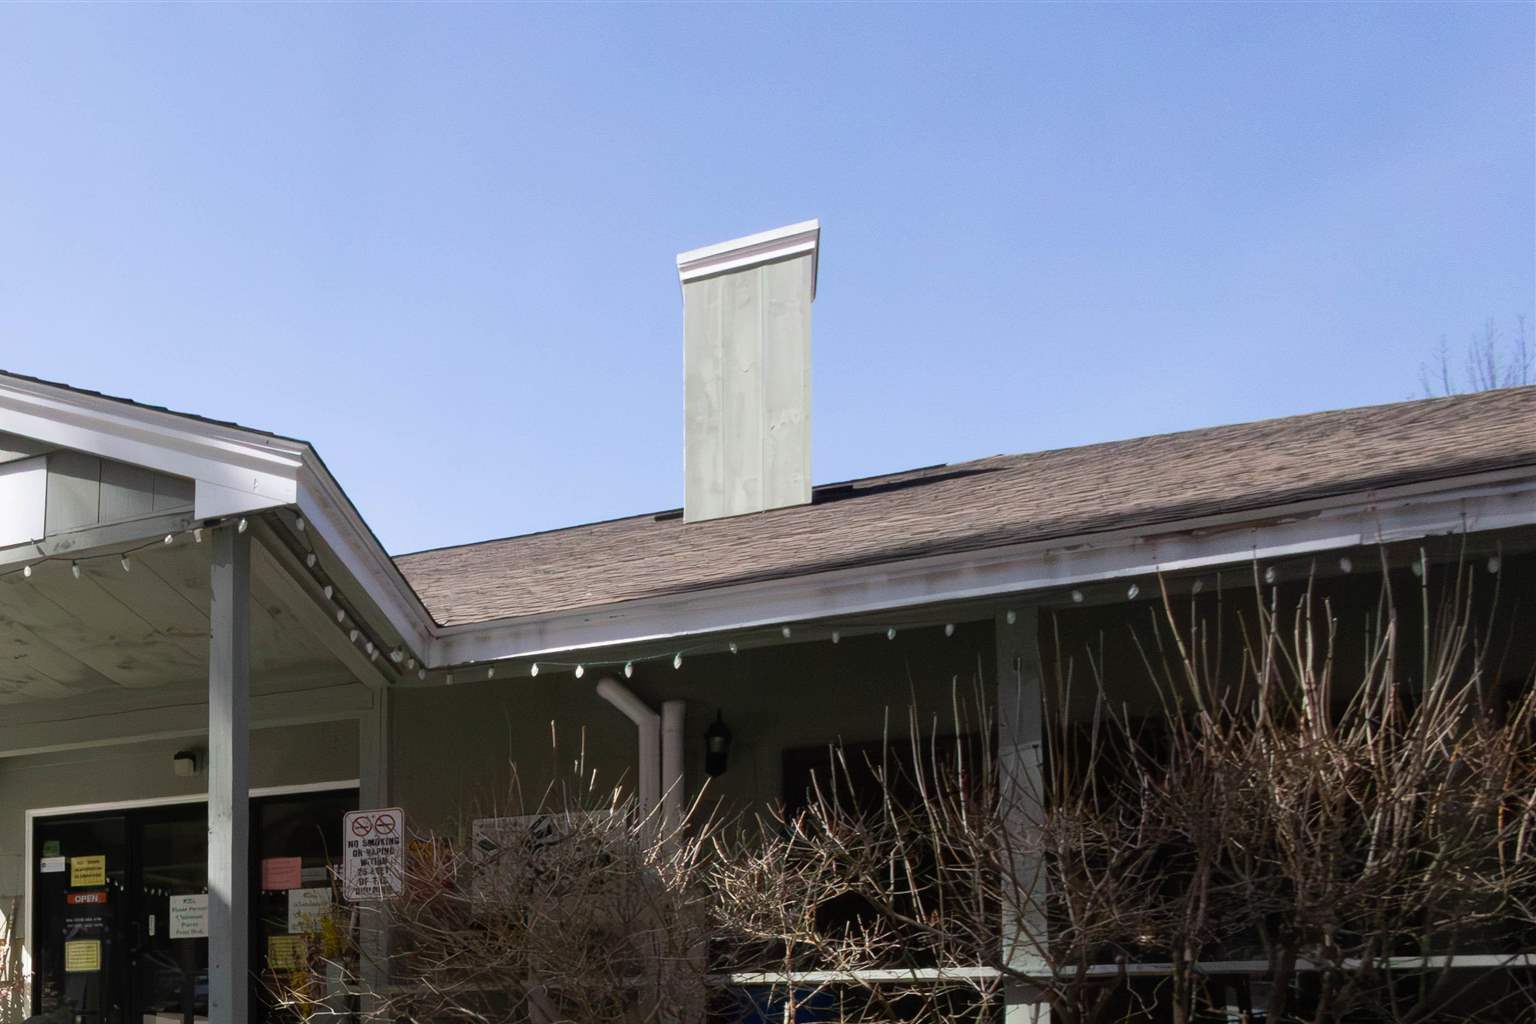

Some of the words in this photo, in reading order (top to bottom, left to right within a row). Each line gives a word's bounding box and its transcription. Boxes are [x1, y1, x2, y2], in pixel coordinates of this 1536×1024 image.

[348, 840, 359, 849] NO
[362, 837, 400, 848] SMOKING
[352, 849, 363, 858] OR
[75, 895, 98, 903] OPEN
